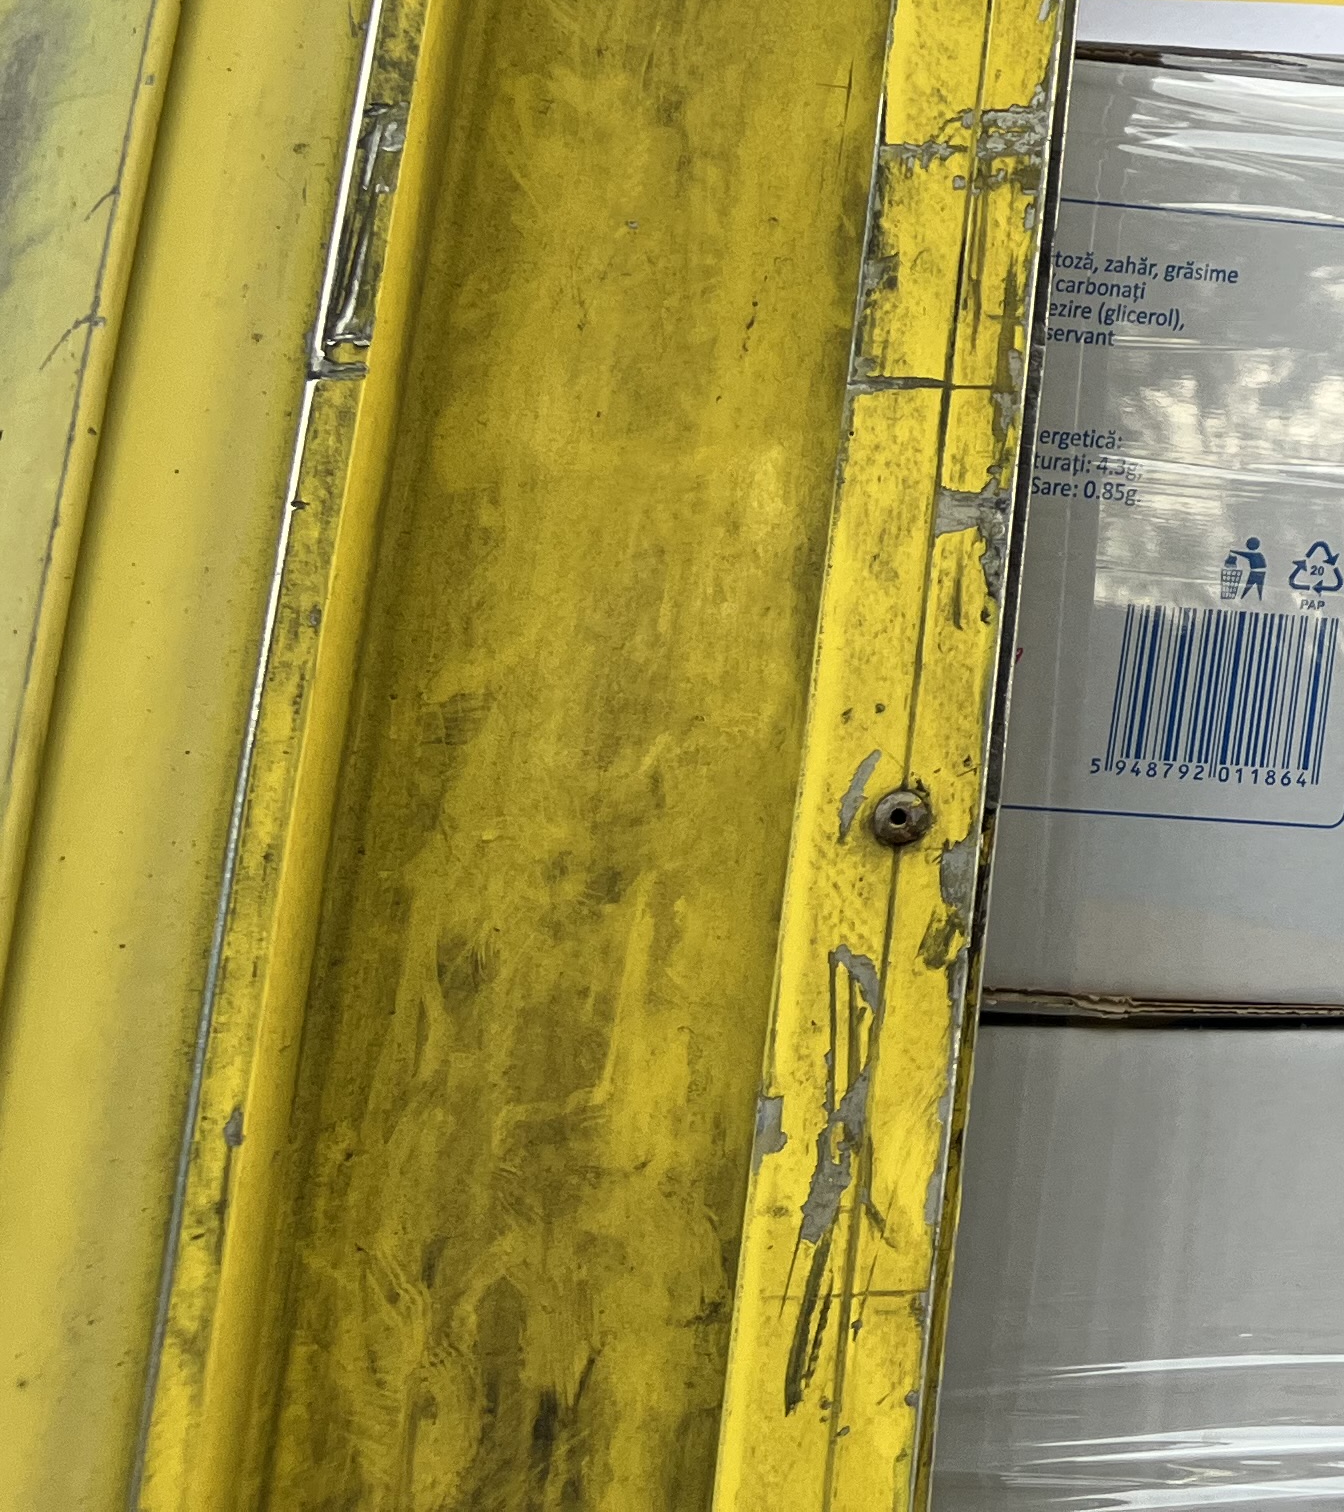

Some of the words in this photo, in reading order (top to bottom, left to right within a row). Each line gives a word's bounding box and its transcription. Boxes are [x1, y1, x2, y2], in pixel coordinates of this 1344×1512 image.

[1104, 256, 1159, 280] zahăr,
[1163, 262, 1239, 284] grăsime
[1098, 302, 1185, 331] (glicerol),
[1083, 480, 1142, 507] 0.85g.
[1310, 565, 1325, 576] 20
[1300, 599, 1325, 611] PAP
[1090, 758, 1102, 775] 5
[1115, 760, 1205, 780] 948792
[1218, 766, 1307, 787] 011864
